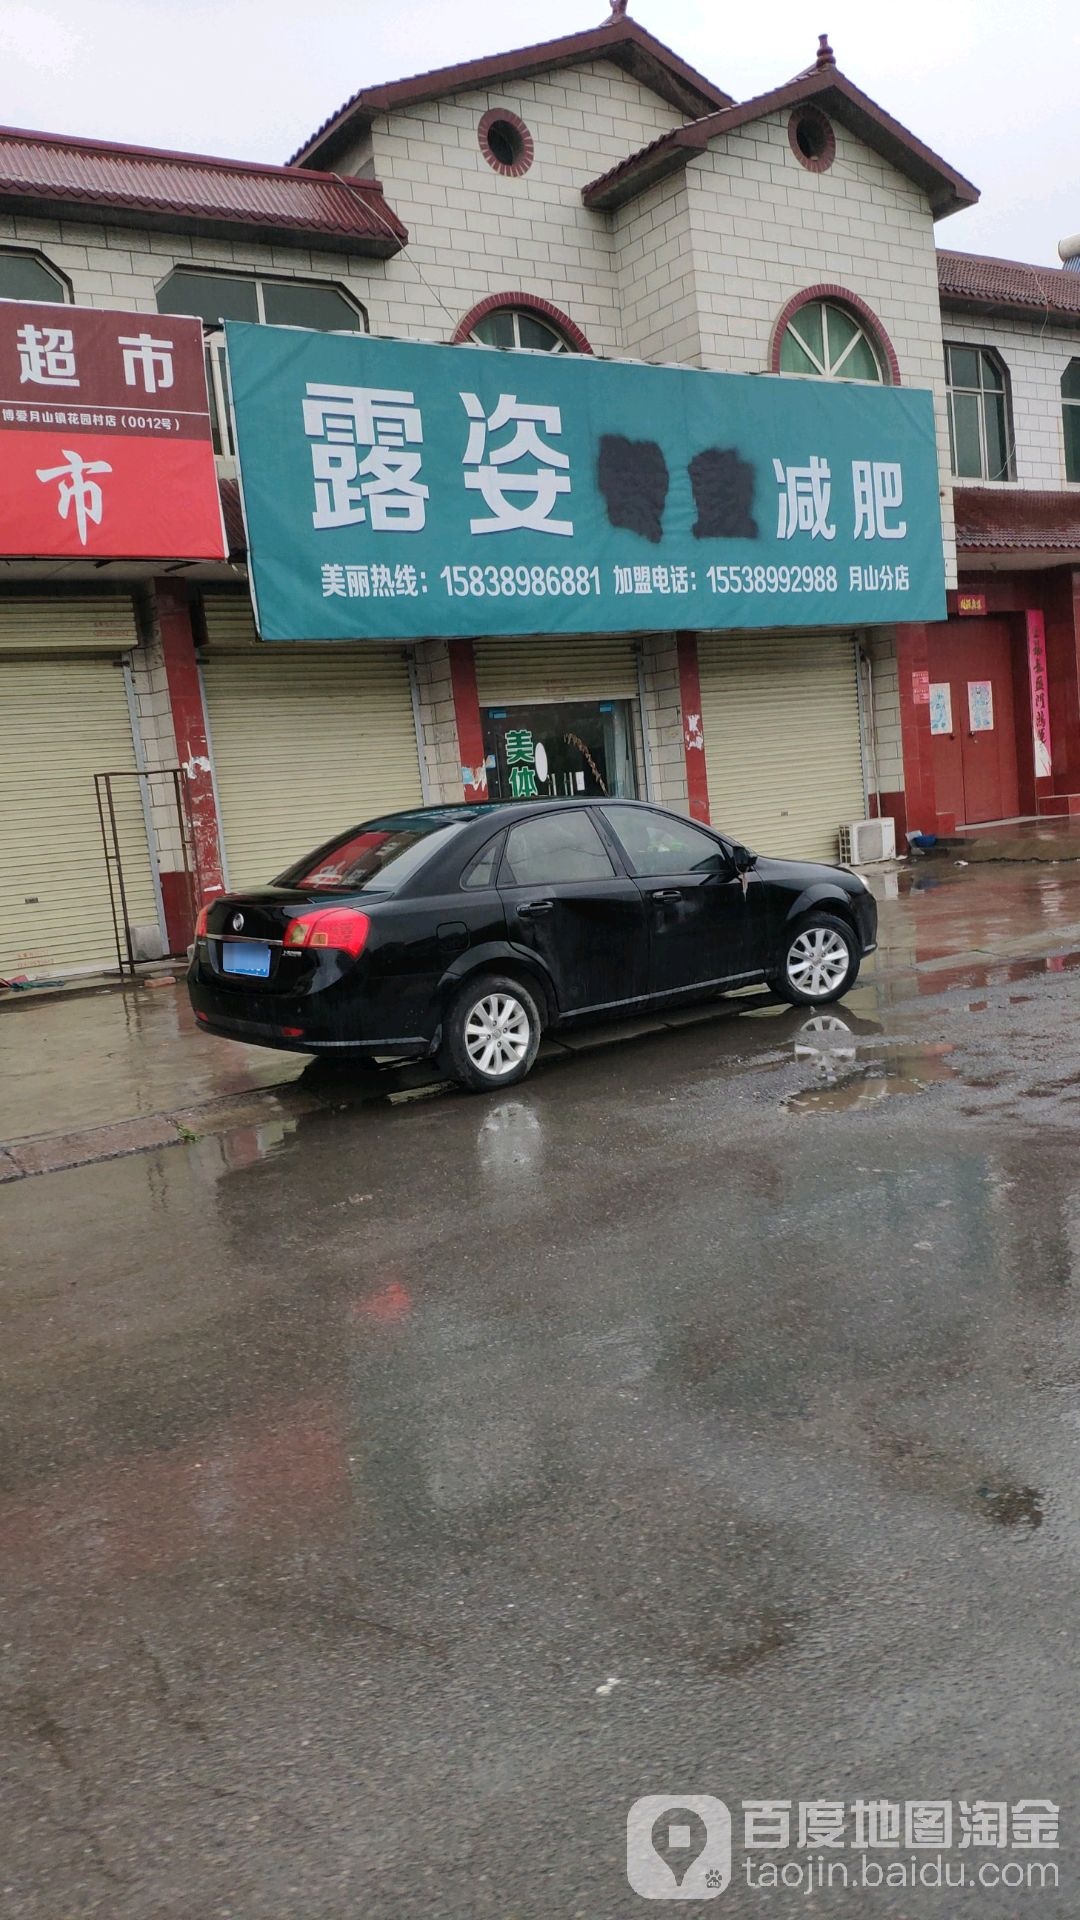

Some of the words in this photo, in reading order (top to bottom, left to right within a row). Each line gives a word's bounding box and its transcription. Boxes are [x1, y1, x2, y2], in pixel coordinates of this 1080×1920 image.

[17, 324, 174, 393] 超市
[302, 382, 574, 536] 露姿
[772, 455, 907, 540] 减肥
[36, 449, 112, 546] 市
[440, 565, 601, 597] 15838986881
[706, 565, 837, 594] 15538992988
[849, 564, 909, 592] 月山分店
[504, 728, 538, 797] 美体
